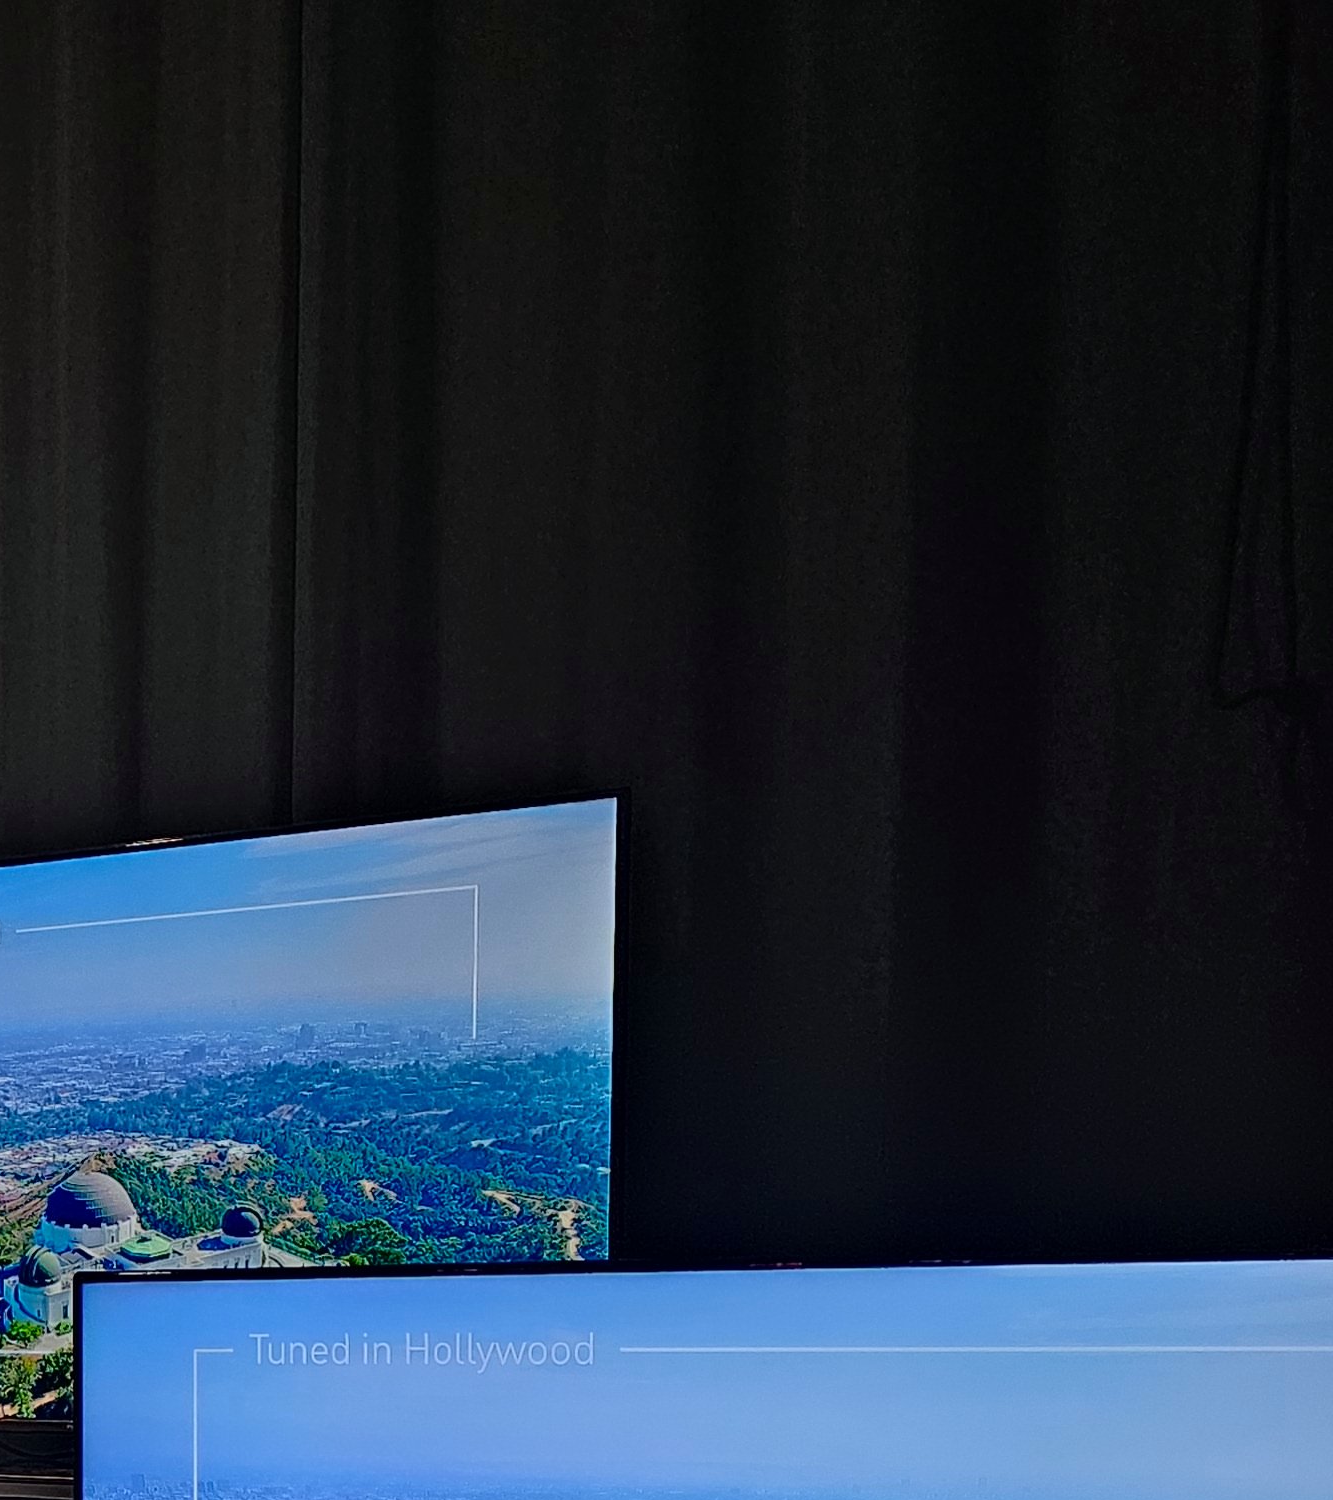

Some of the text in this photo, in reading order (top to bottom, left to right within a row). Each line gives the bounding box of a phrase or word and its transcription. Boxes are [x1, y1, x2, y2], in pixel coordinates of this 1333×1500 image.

[249, 1332, 595, 1374] Tuned in Hollywood
